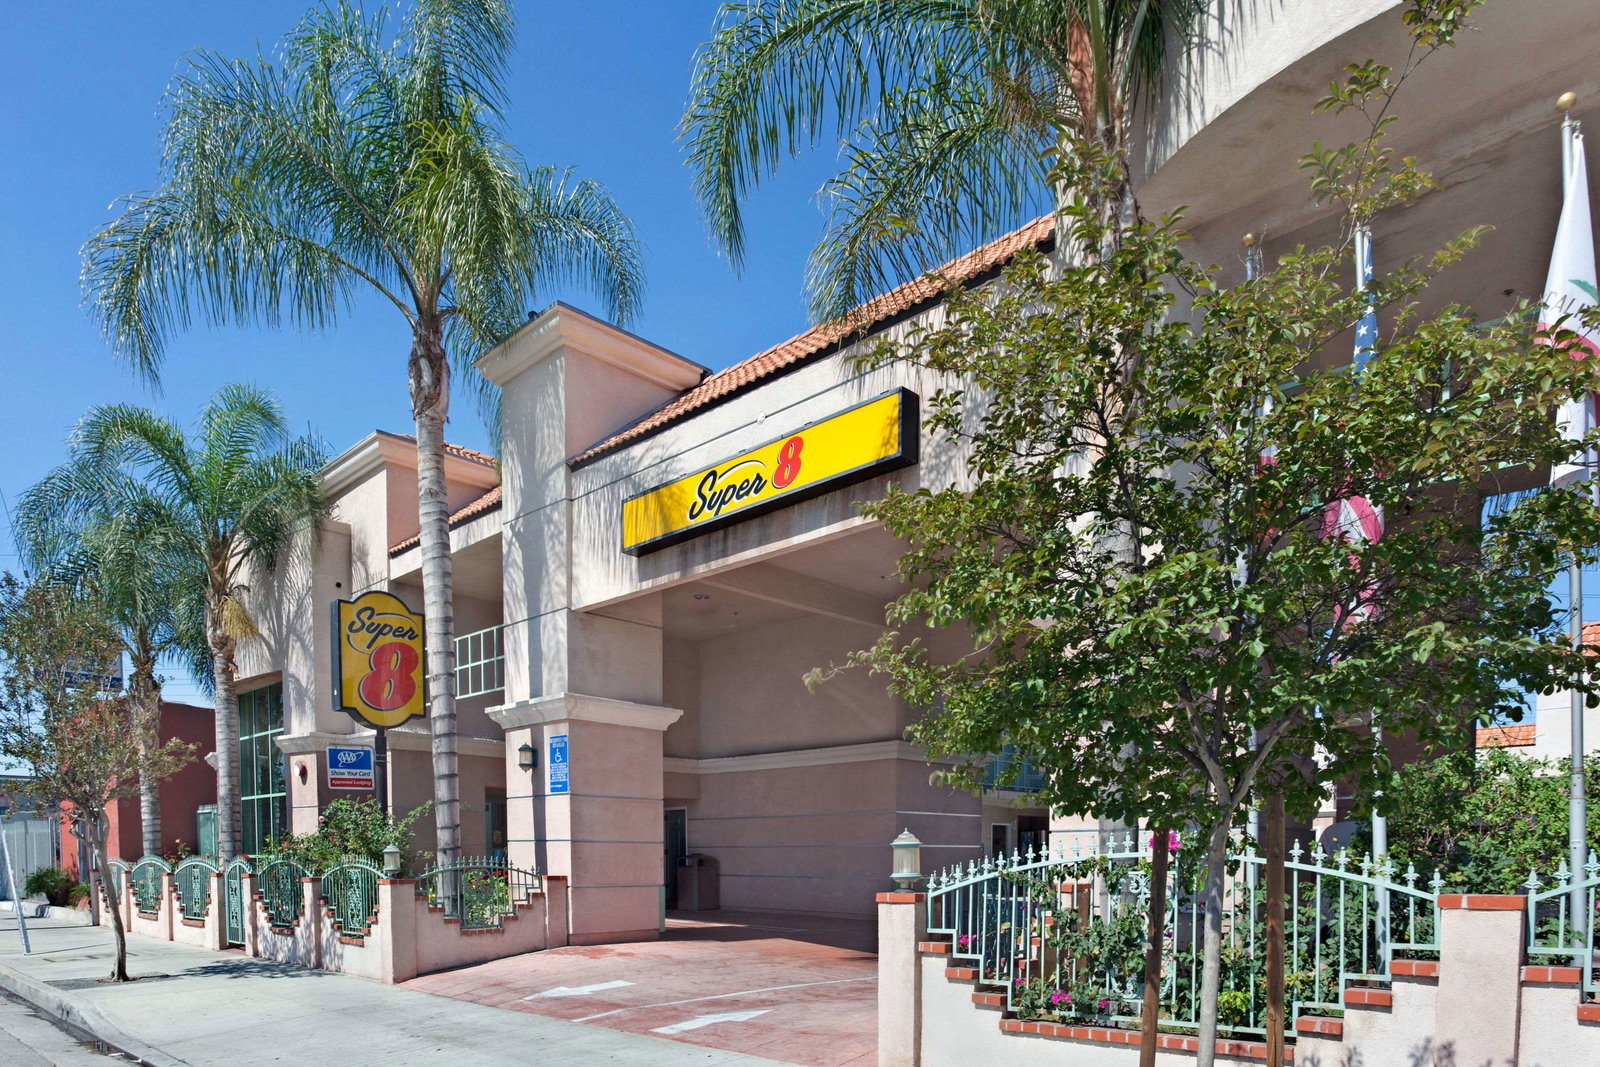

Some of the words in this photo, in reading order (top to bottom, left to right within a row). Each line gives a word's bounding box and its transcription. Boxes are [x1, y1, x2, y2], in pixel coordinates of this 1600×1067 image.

[687, 468, 768, 520] Super
[772, 436, 803, 488] 8
[348, 606, 419, 649] Super
[359, 642, 419, 711] 8
[338, 751, 356, 763] AAA
